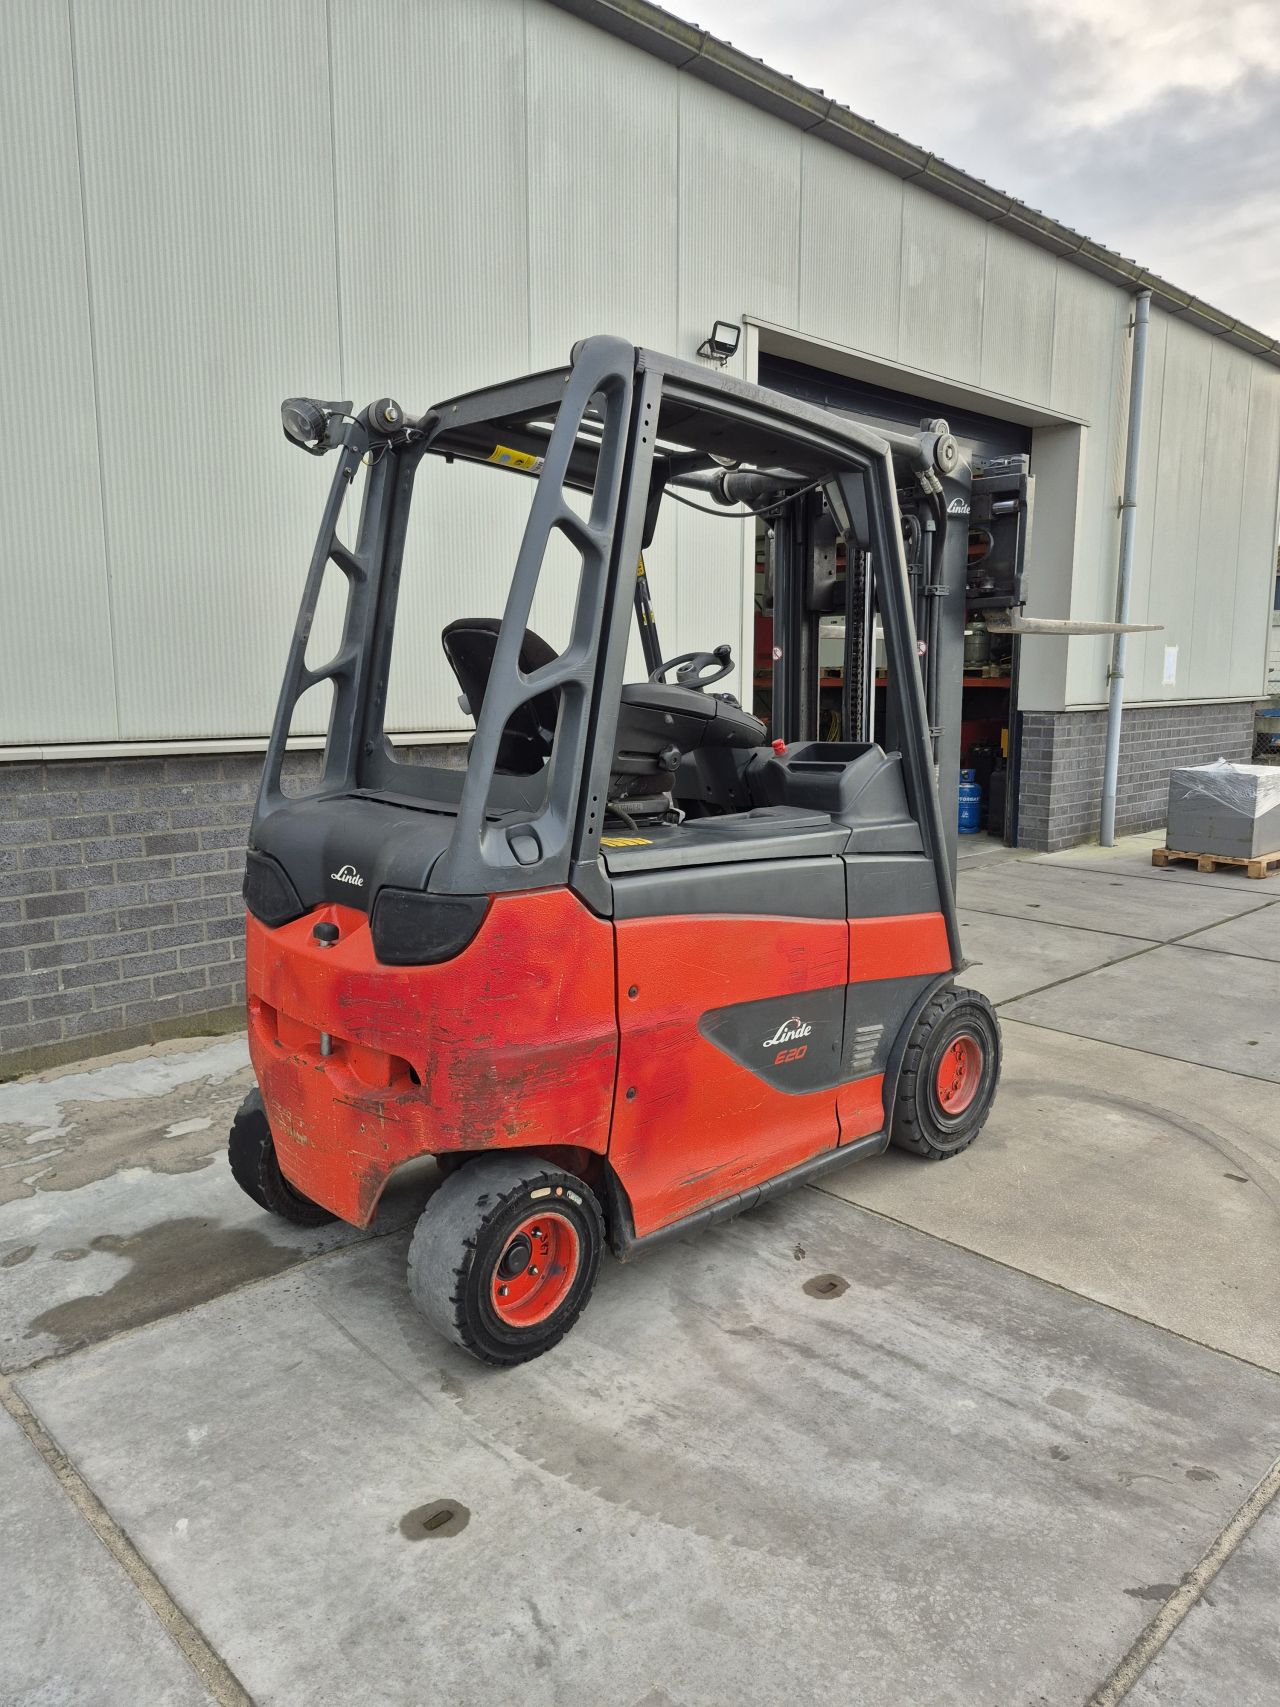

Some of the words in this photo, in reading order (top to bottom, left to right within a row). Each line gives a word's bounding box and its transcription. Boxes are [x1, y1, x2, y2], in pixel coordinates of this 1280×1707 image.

[947, 498, 971, 514] Linde
[331, 865, 364, 887] Linde
[762, 1016, 812, 1048] Linde
[774, 1045, 808, 1065] E20
